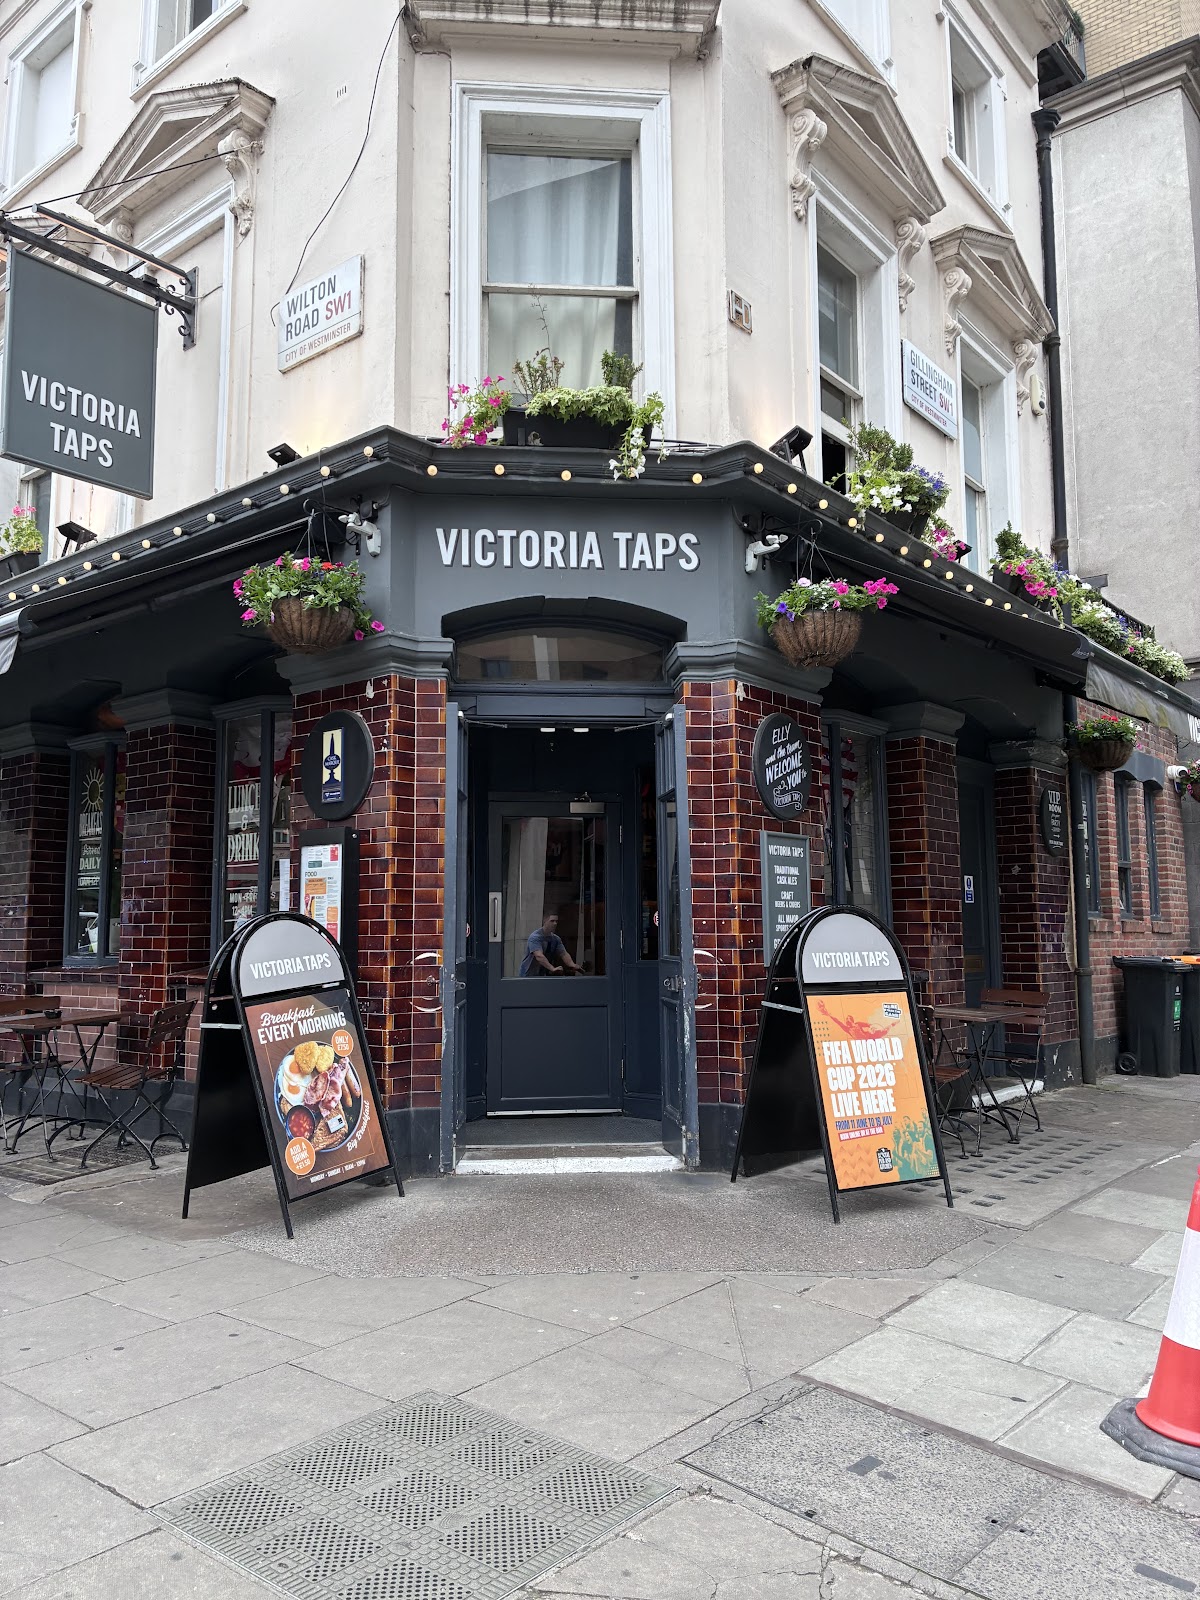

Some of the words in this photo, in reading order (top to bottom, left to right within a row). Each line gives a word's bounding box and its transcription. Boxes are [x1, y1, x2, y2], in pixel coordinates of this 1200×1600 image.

[286, 275, 336, 317] WILTON
[285, 308, 319, 342] ROAD
[325, 290, 351, 321] SW1
[285, 349, 298, 362] CITY
[299, 344, 307, 356] OF
[308, 322, 351, 351] WESTMINSTER
[910, 349, 953, 398] GILLINGHAM
[910, 369, 937, 402] STREET
[939, 392, 953, 416] SW1
[21, 370, 141, 438] VICTORIA
[911, 393, 919, 404] CITY
[919, 400, 924, 410] OF
[924, 405, 947, 427] WESTMINSTER
[50, 421, 113, 468] TAPS
[436, 528, 604, 570] VICTORIA
[613, 531, 700, 572] TAPS
[772, 723, 791, 745] ELLY
[765, 748, 776, 766] and
[777, 745, 786, 759] the
[765, 750, 802, 785] WELCOME
[787, 769, 802, 789] YOU
[228, 782, 261, 814] LUNCH
[1047, 790, 1060, 804] VIP
[1048, 803, 1062, 813] ROOM
[768, 844, 791, 857] VICTORIA
[792, 846, 804, 858] TAPS
[79, 857, 101, 871] DAILY
[774, 865, 800, 876] TRADITIONAL
[776, 875, 787, 885] CASK
[787, 876, 798, 886] ALES
[780, 891, 794, 901] CRAFT
[785, 914, 799, 923] MAJOR
[250, 957, 305, 979] VICTORIA
[303, 953, 332, 971] TAPS
[811, 952, 862, 968] VICTORIA
[861, 950, 890, 967] TAPS
[260, 1005, 316, 1027] Breakfast
[257, 1023, 294, 1045] EVERY
[297, 1012, 347, 1036] MORNING
[335, 1035, 349, 1044] ONLY
[822, 1041, 852, 1066] FIFA
[850, 1037, 904, 1064] WORLD
[826, 1066, 855, 1091] CUP
[856, 1063, 897, 1089] 2026
[830, 1091, 862, 1118] LIVE
[860, 1088, 897, 1115] HERE
[346, 1139, 358, 1152] Big
[355, 1100, 371, 1141] Breakfast
[835, 1120, 850, 1130] FROM
[850, 1119, 855, 1129] 11
[856, 1118, 868, 1128] JUNE
[868, 1117, 874, 1126] TO
[882, 1116, 893, 1125] JULY
[289, 1143, 302, 1156] ADD
[301, 1141, 307, 1150] A
[292, 1150, 309, 1164] DRINK
[310, 1173, 325, 1183] MONDAY
[328, 1167, 341, 1177] SUNDAY
